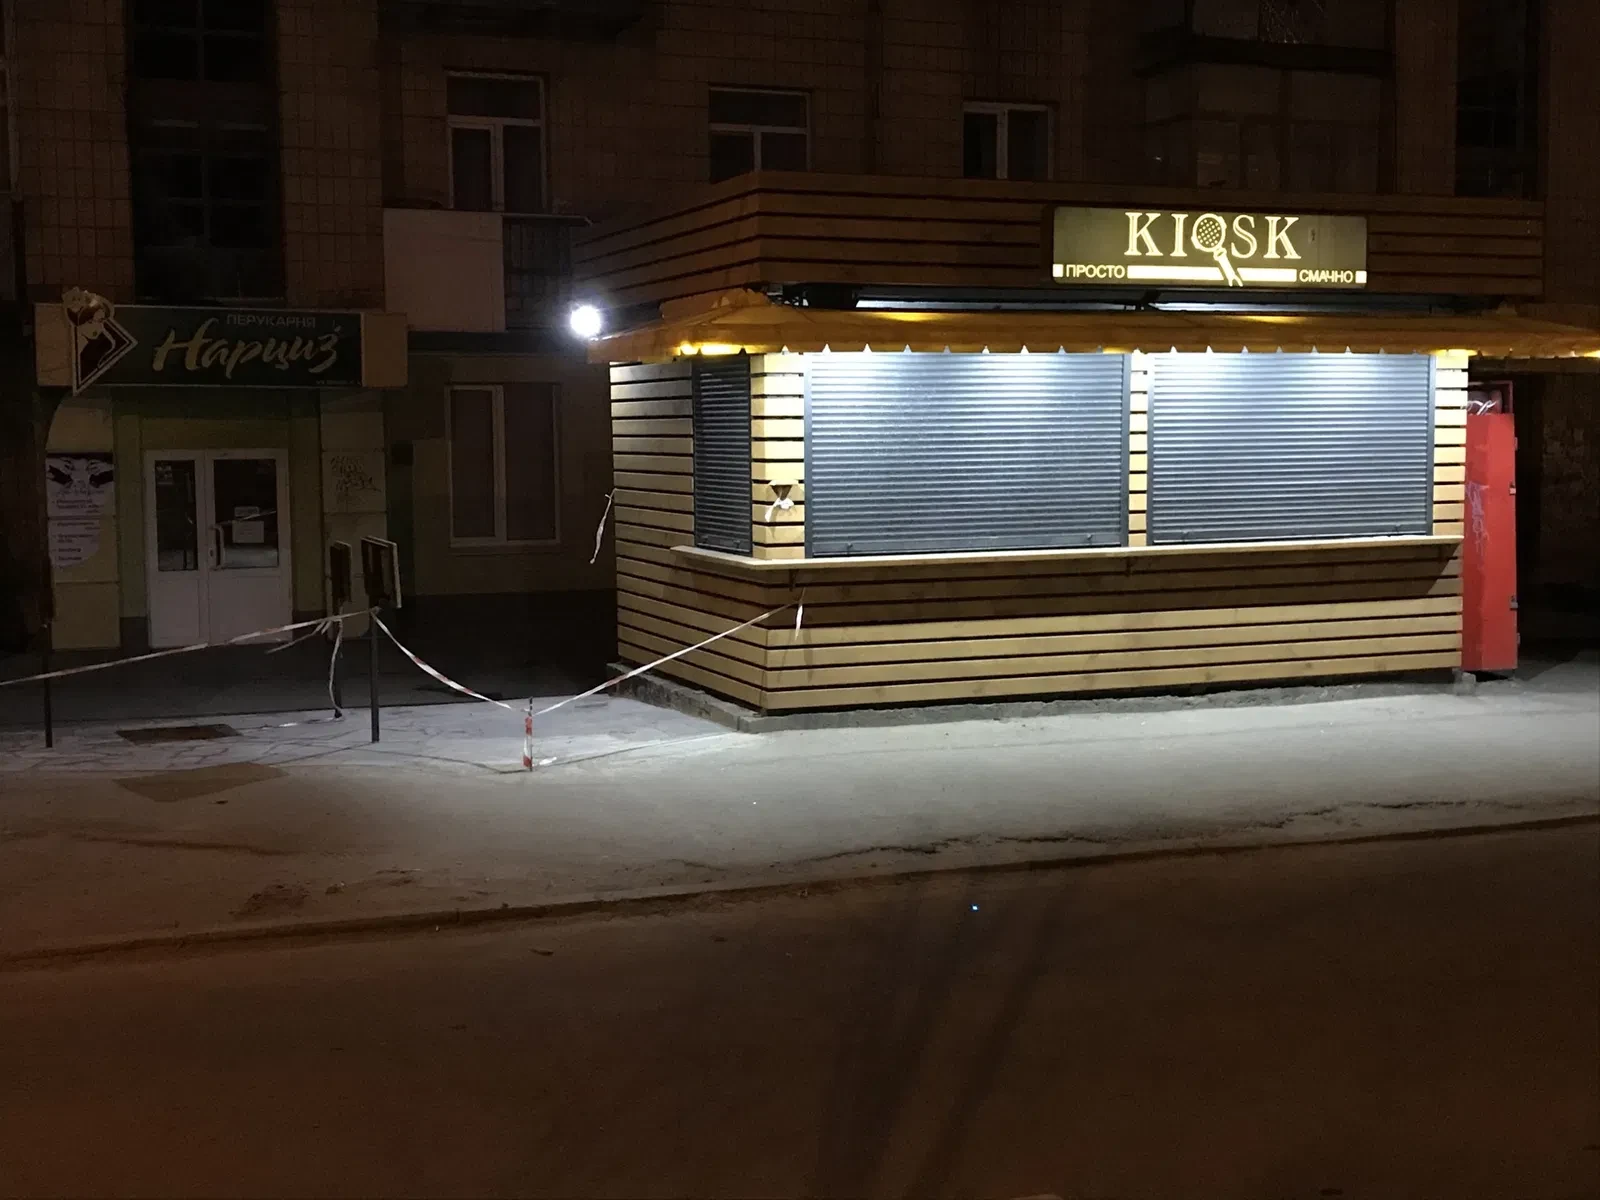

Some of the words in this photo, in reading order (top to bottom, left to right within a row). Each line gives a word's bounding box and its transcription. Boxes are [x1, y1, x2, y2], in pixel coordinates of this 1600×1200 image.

[1123, 211, 1302, 262] KIOSK
[1065, 264, 1127, 280] ПРОСТО
[1298, 269, 1354, 284] СМАЧНО
[225, 313, 318, 329] ПЕРУКАРНЯ
[151, 316, 340, 380] Нарциз
